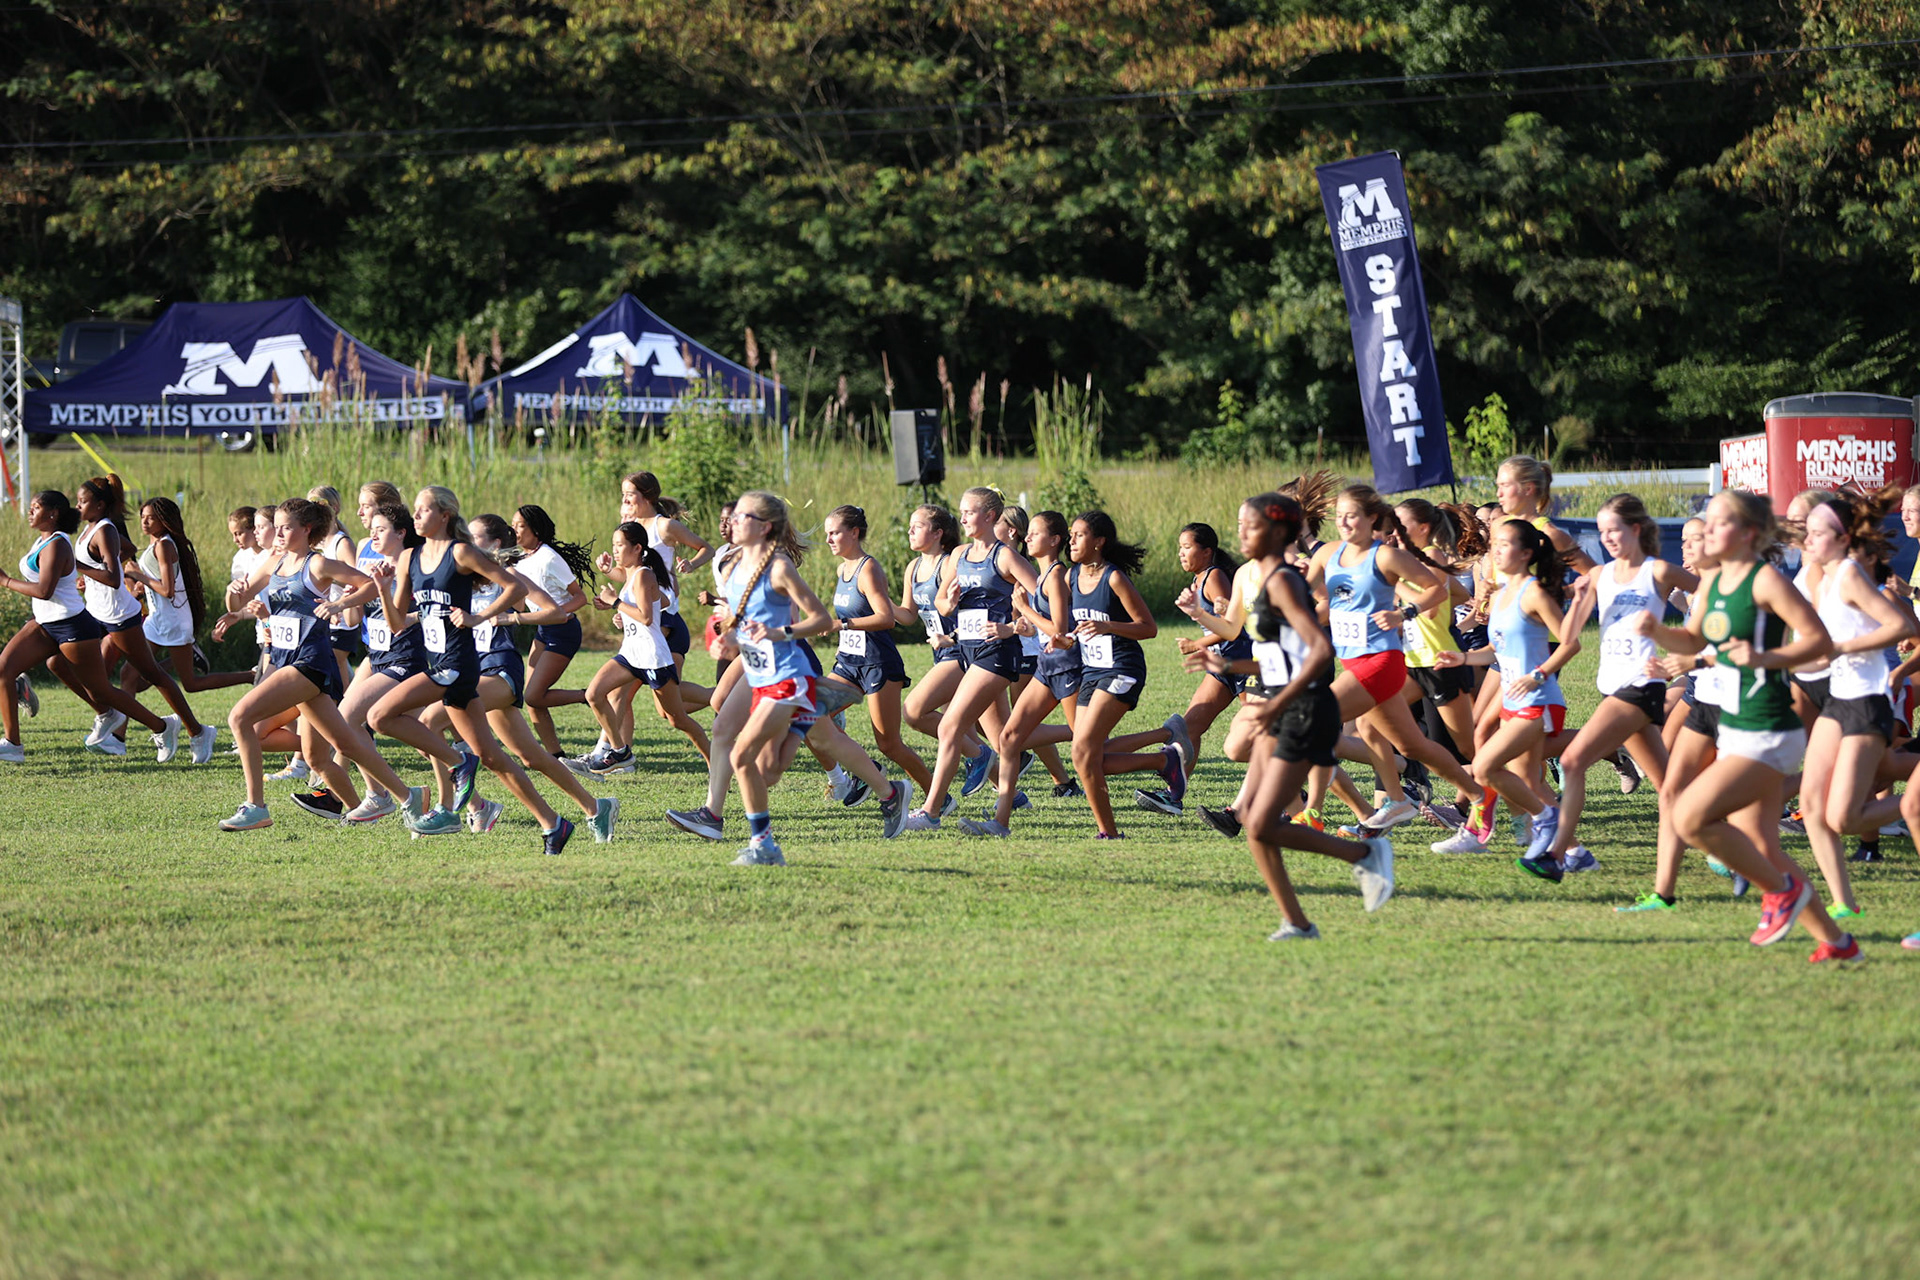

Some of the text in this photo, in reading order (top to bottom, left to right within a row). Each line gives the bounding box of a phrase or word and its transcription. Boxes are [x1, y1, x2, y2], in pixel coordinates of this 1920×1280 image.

[1338, 217, 1406, 242] MEMPHIS
[1364, 253, 1425, 467] START
[50, 404, 189, 427] MEMPHIS
[197, 406, 288, 424] YOUTH
[1797, 440, 1897, 462] MEMPHIS
[1806, 461, 1885, 477] RUNNERS
[1807, 480, 1885, 489] TRACK CLUB
[959, 575, 982, 588] SMS
